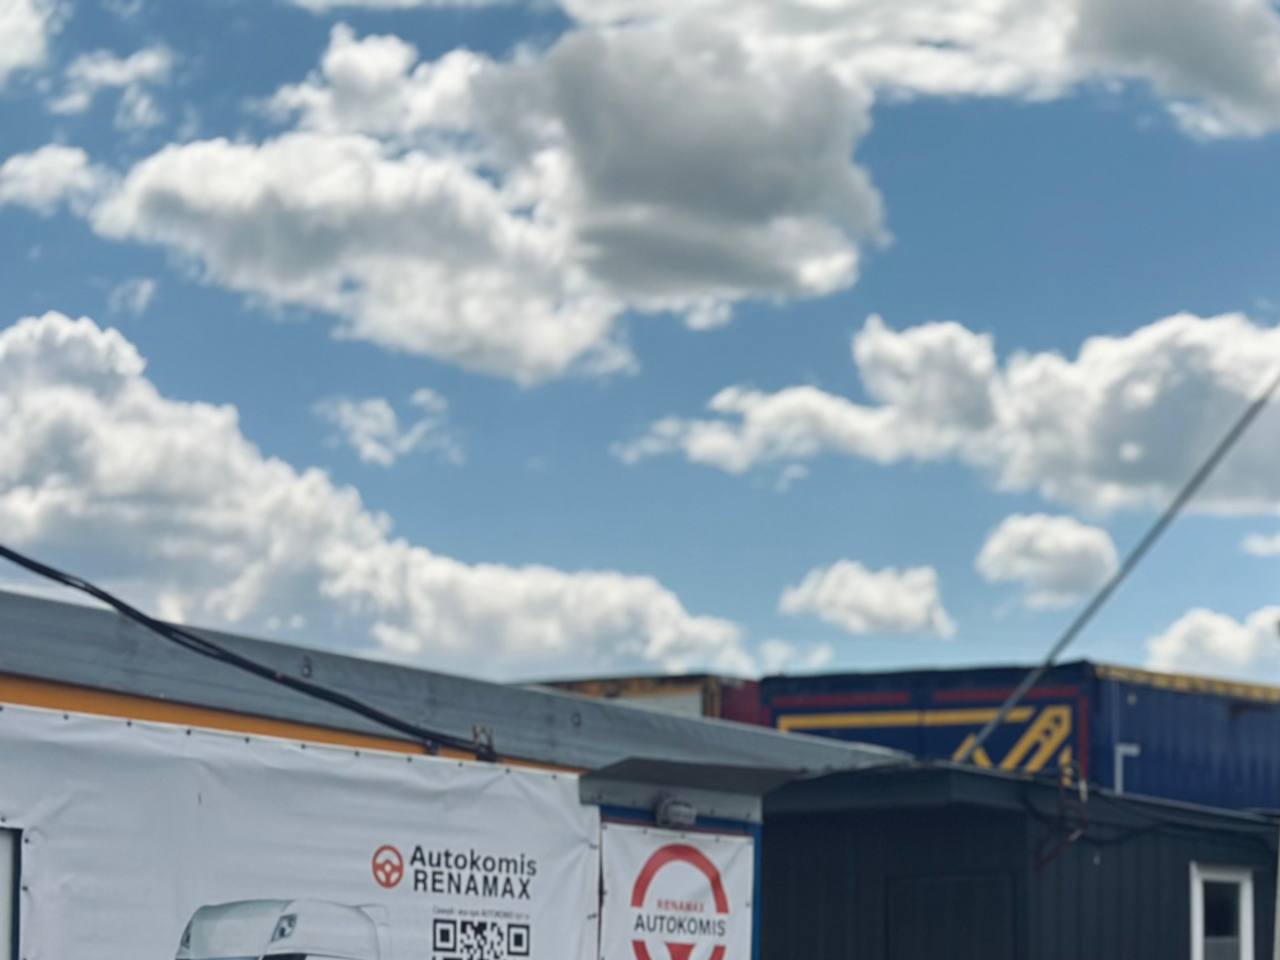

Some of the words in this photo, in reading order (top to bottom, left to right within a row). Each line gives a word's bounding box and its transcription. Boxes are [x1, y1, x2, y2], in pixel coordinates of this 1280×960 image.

[409, 845, 537, 876] Autokomis
[413, 869, 531, 900] RENAMAX
[633, 914, 726, 937] AUTOKOMIS
